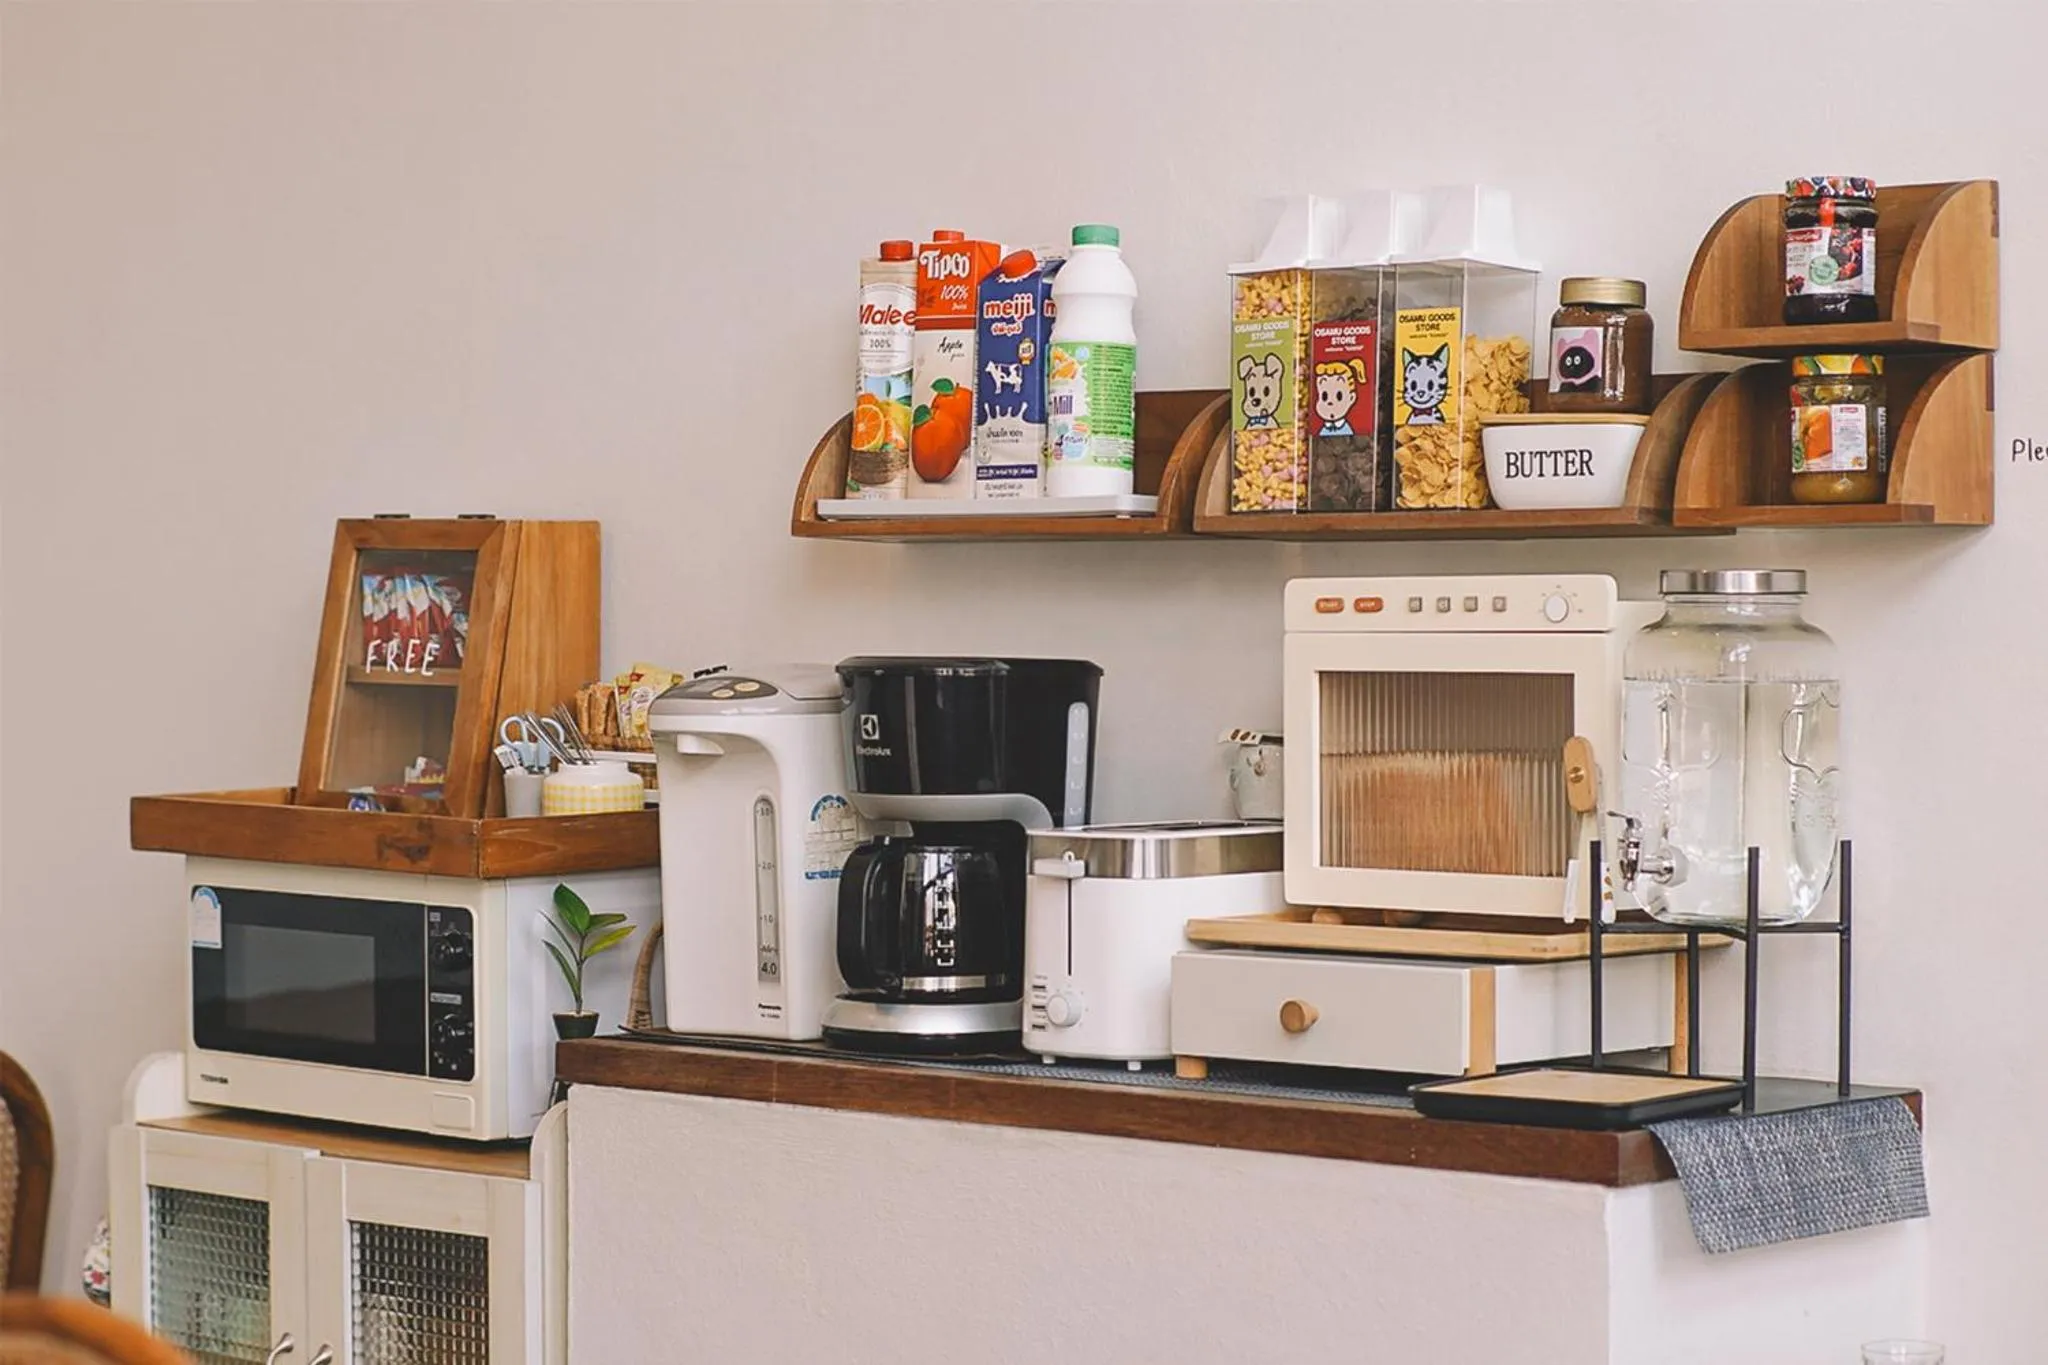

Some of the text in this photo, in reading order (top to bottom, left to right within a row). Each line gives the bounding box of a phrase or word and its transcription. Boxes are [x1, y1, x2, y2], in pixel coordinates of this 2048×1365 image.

[920, 249, 970, 280] Tipco
[941, 285, 969, 300] 100%
[985, 293, 1034, 320] meiji
[1399, 313, 1455, 323] OSAMU GOODS
[1315, 326, 1371, 337] OSAMU GOODS
[1416, 323, 1440, 332] STORE
[1251, 331, 1275, 341] STORE
[1331, 336, 1356, 345] STORE
[938, 336, 963, 353] Apple
[2012, 438, 2048, 462] Ple
[1505, 450, 1594, 478] BUTTER
[366, 639, 440, 676] FREE
[761, 962, 777, 975] 4.0
